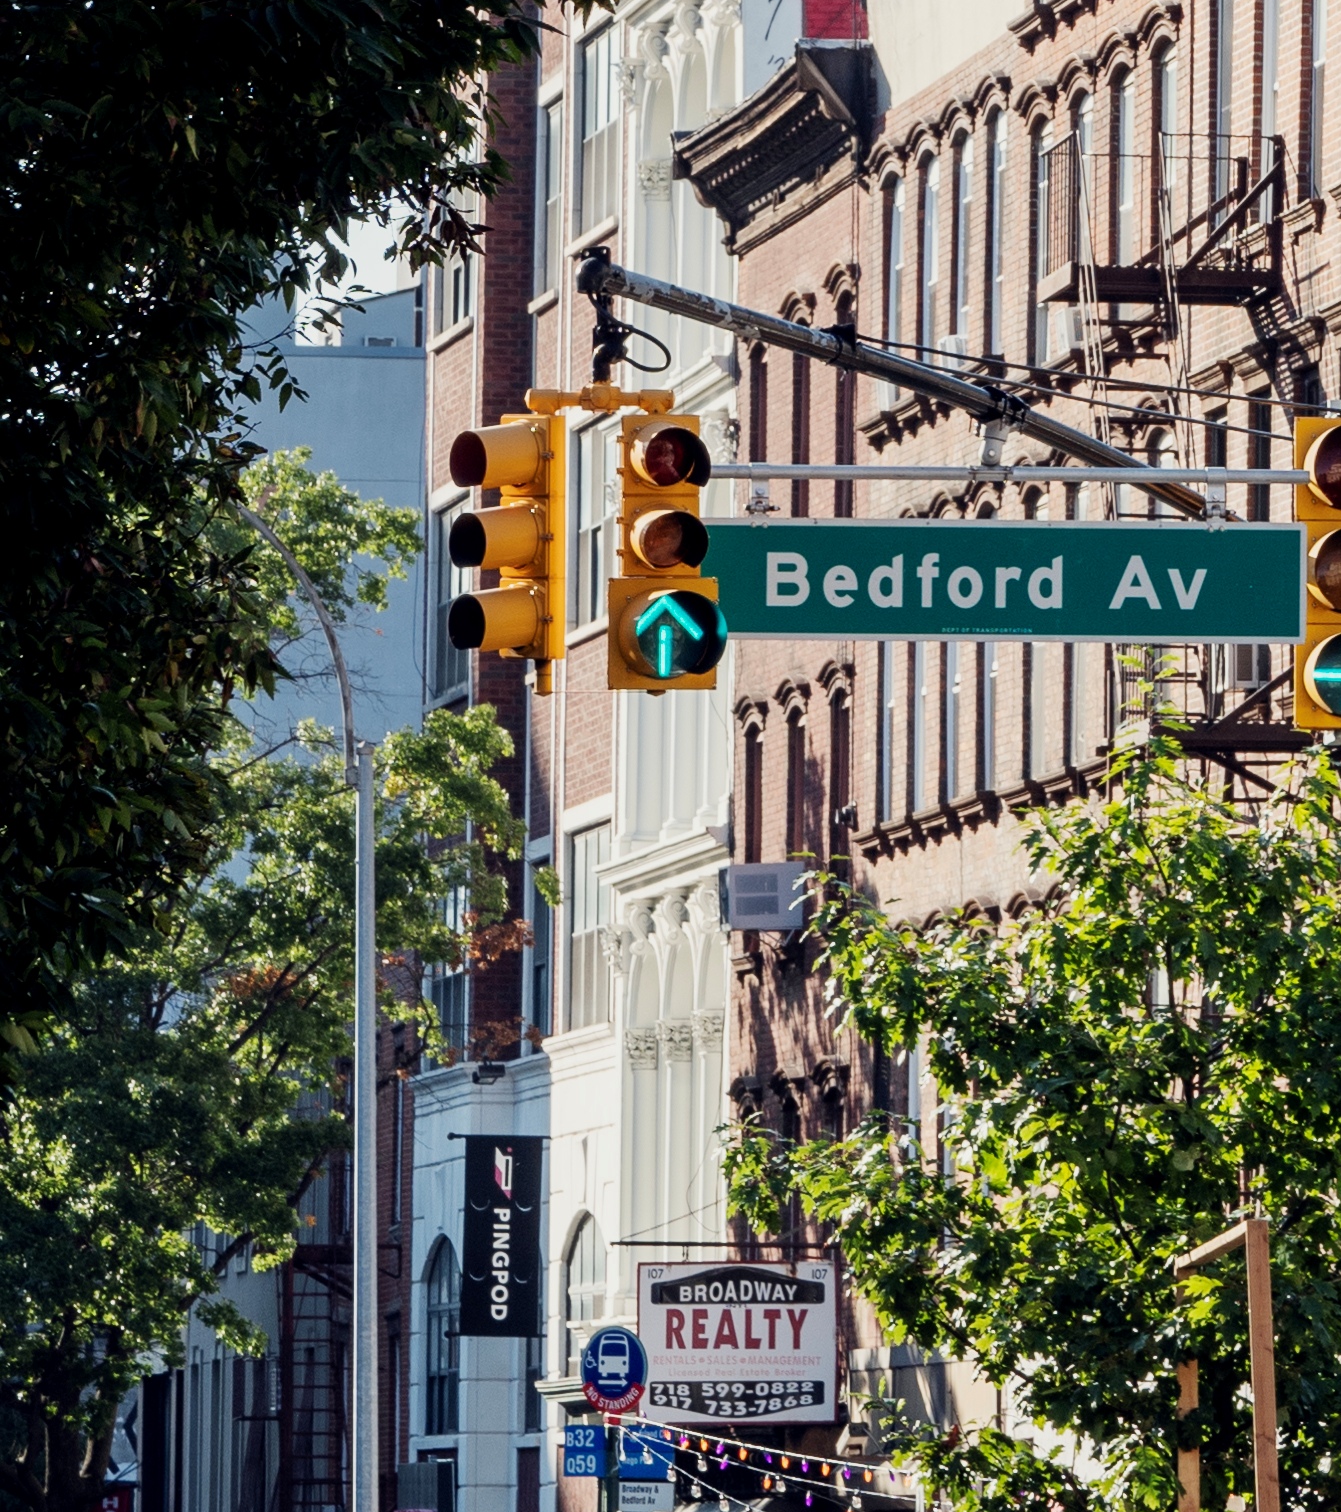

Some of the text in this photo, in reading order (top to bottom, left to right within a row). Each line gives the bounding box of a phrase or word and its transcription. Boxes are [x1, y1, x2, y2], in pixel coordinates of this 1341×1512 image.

[766, 551, 1208, 610] Bedford Av
[491, 1208, 511, 1321] PINGPOD
[648, 1269, 664, 1279] 107
[811, 1269, 828, 1280] 107
[679, 1280, 798, 1302] BROADWAY
[665, 1309, 809, 1350] REALTY
[653, 1355, 822, 1366] RENTALS SALES MANAGEMENT
[668, 1368, 711, 1377] Licensed
[716, 1368, 736, 1377] Real
[775, 1368, 806, 1377] Broker
[586, 1386, 639, 1410] NO STANDING
[651, 1382, 815, 1397] 718 599-0822
[653, 1395, 813, 1416] 917 733-7868
[566, 1429, 595, 1448] B32
[566, 1454, 597, 1474] Q59
[621, 1484, 652, 1496] Broadway
[621, 1494, 655, 1505] Bedford Av
